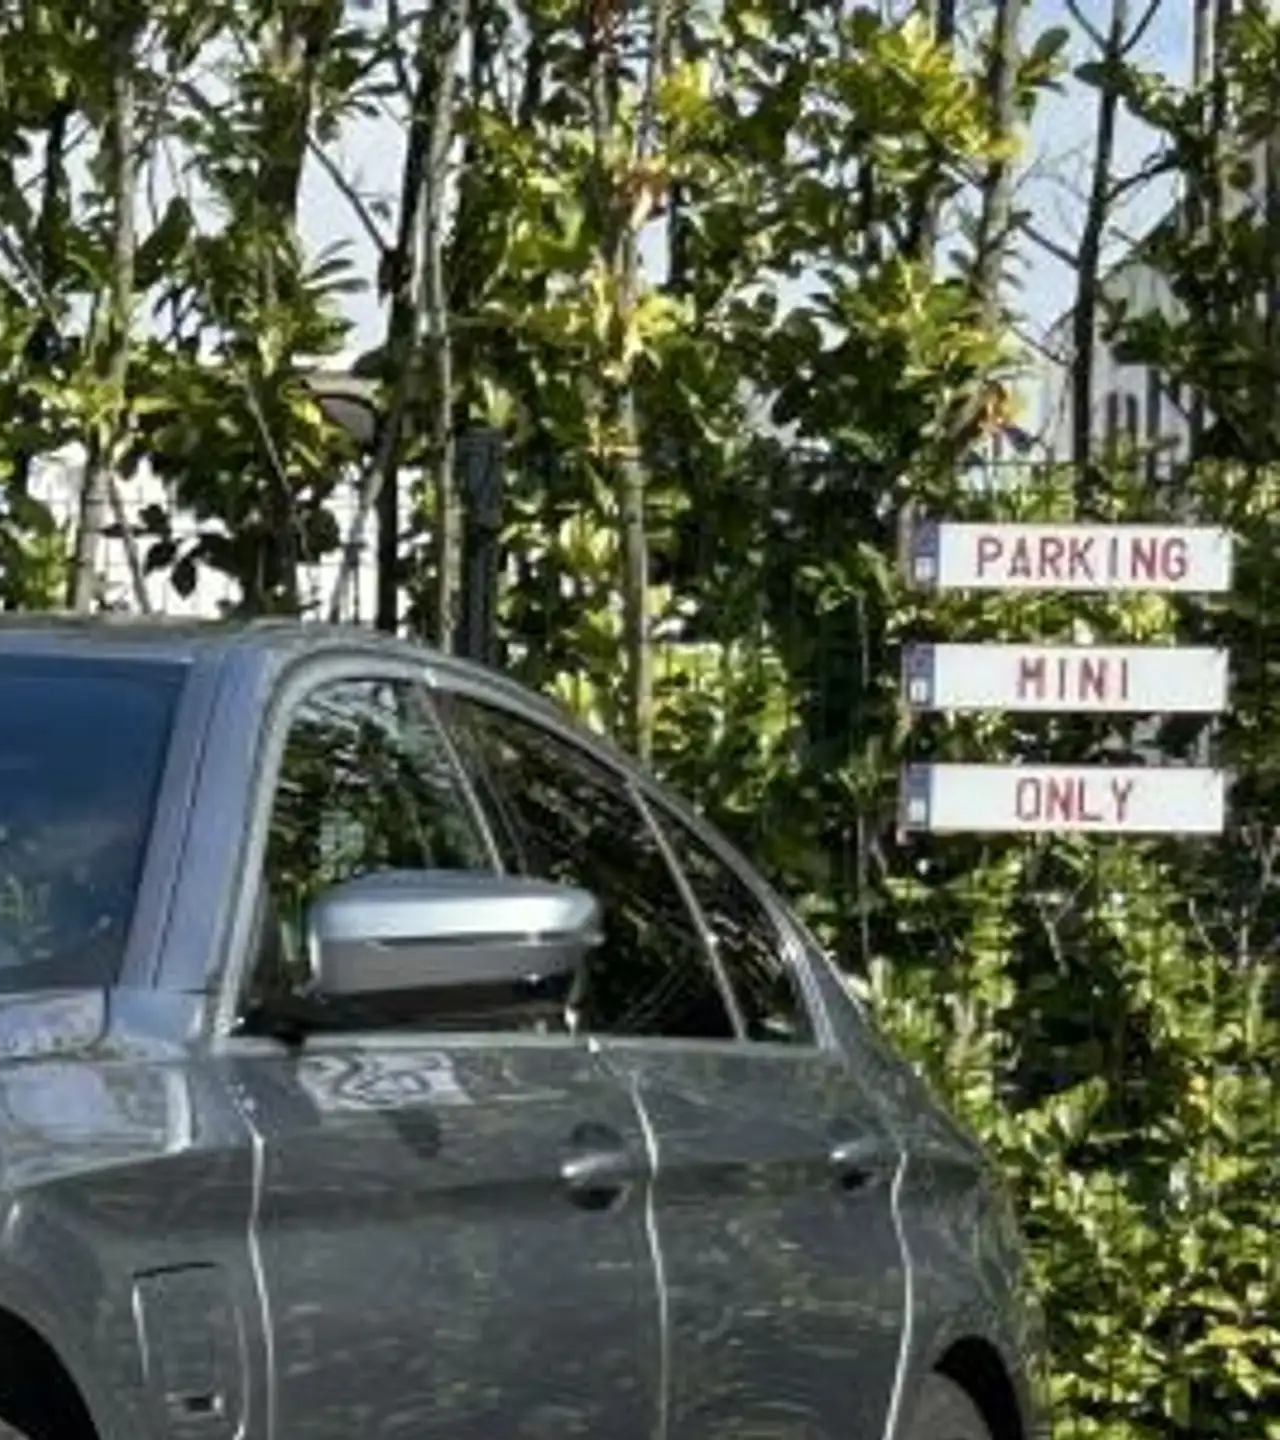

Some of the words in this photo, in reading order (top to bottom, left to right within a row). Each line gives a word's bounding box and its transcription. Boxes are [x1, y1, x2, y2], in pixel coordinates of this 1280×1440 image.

[977, 535, 1188, 582] PARKING
[1017, 657, 1128, 700] MINI
[1016, 777, 1133, 823] ONLY
